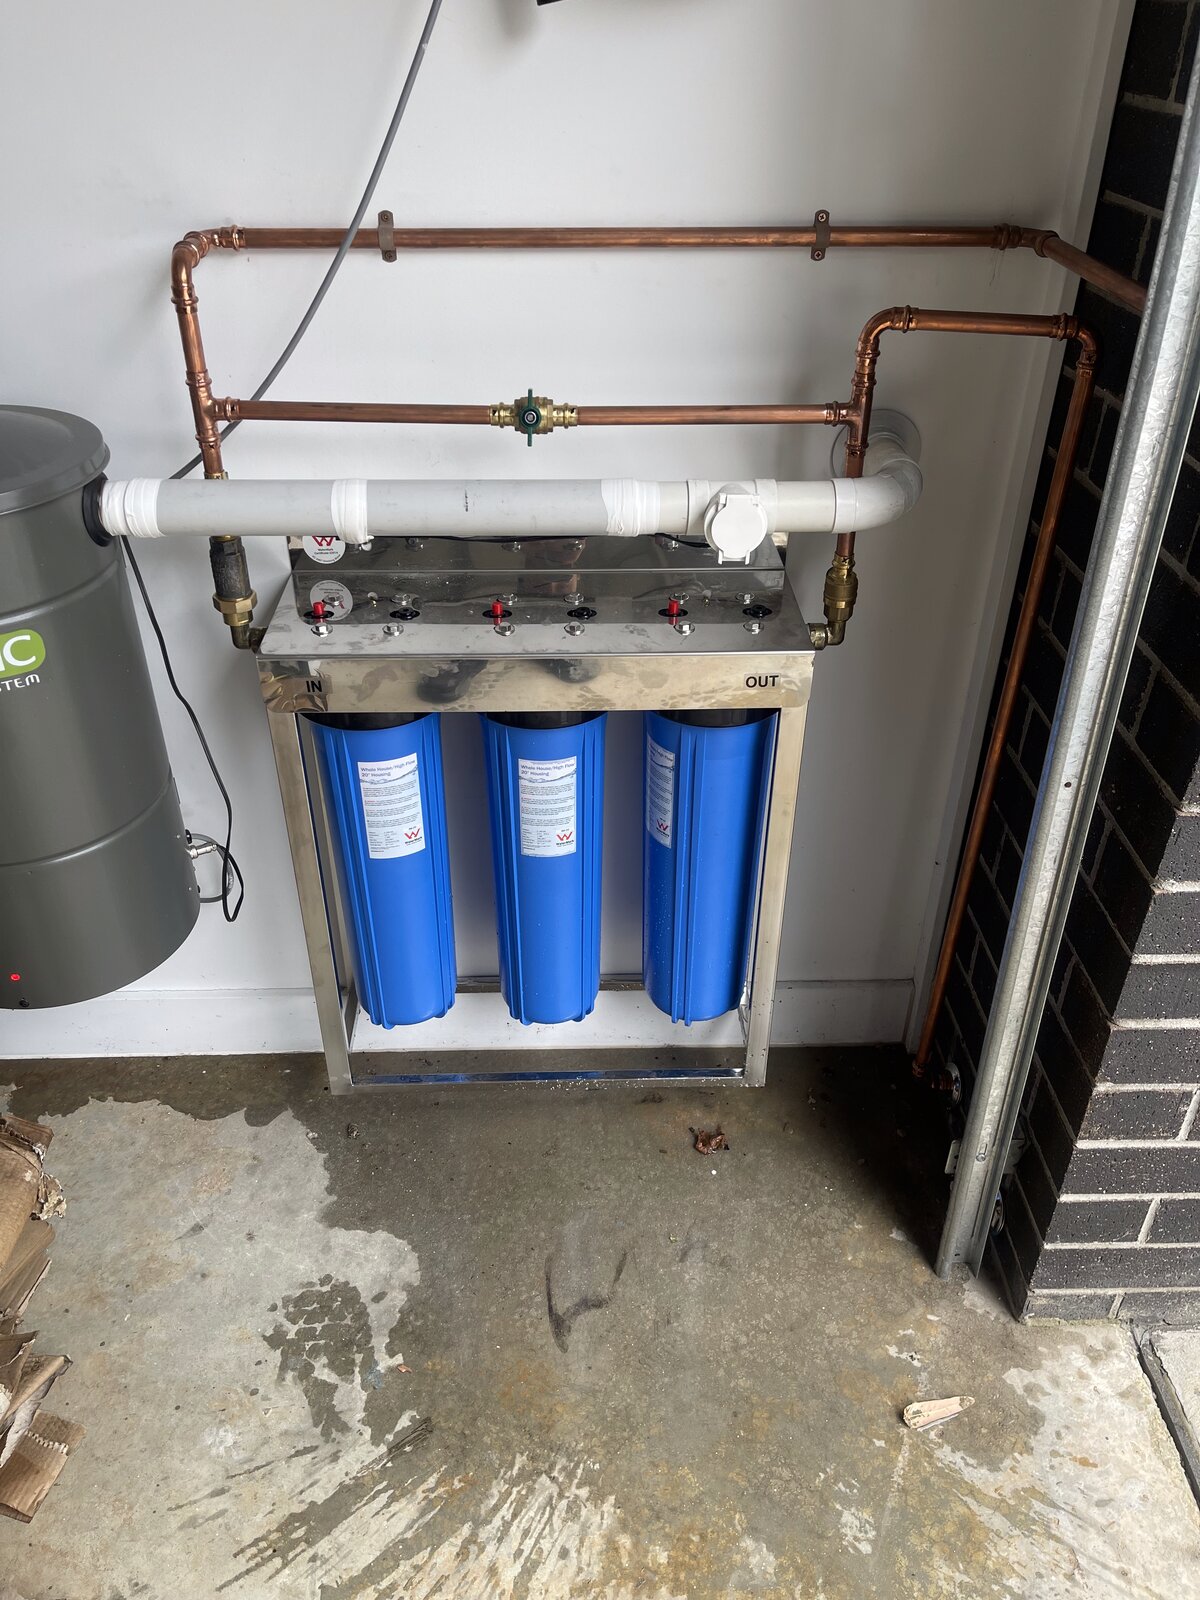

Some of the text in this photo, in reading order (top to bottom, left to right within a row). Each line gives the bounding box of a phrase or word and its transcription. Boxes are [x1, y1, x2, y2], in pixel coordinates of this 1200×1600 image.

[0, 634, 37, 671] C
[0, 673, 40, 692] TEM
[306, 680, 322, 693] IN
[745, 675, 779, 688] OUT
